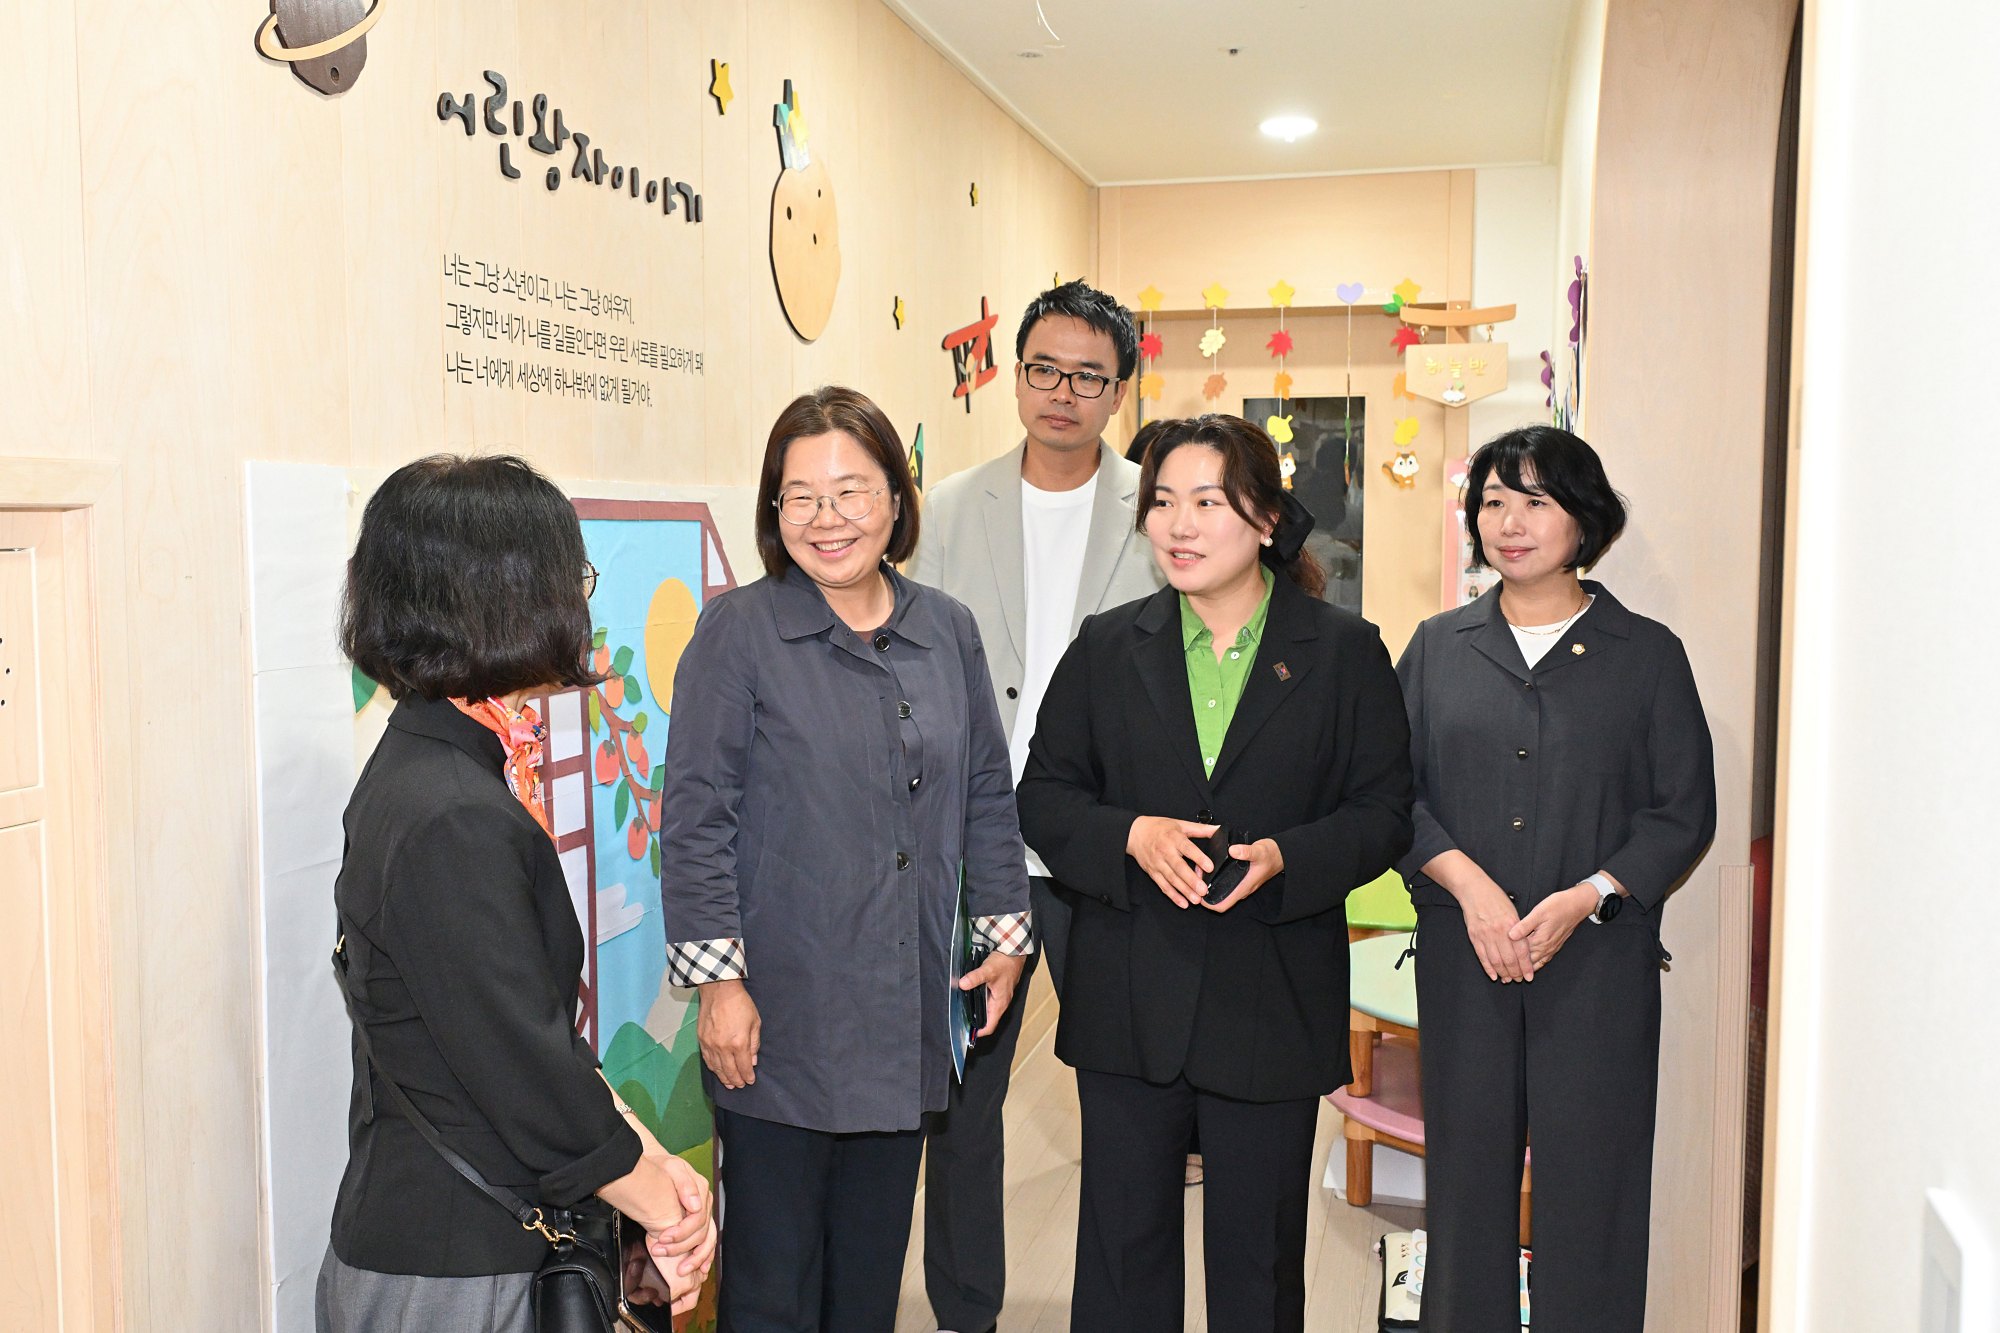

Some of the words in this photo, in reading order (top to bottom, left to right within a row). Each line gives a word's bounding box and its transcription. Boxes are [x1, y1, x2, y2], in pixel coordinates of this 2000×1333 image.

[444, 253, 471, 287] 너는
[474, 261, 500, 294] 그냥
[503, 267, 553, 308] 소년이고,
[555, 281, 578, 311] 나는
[580, 287, 601, 317] 그냥
[603, 293, 635, 325] 여우지.
[445, 302, 499, 340] 그렇지만
[501, 313, 525, 346] 네가
[528, 318, 551, 350] 나를
[553, 323, 606, 360] 길들인다면
[609, 335, 628, 363] 우린
[631, 339, 658, 369] 서로를
[660, 345, 694, 375] 필요하게
[446, 351, 473, 384] 나는
[476, 355, 514, 390] 너에게
[517, 362, 552, 395] 세상에
[555, 368, 597, 400] 하나밖에
[598, 375, 619, 404] 없게
[621, 378, 653, 408] 될거야.
